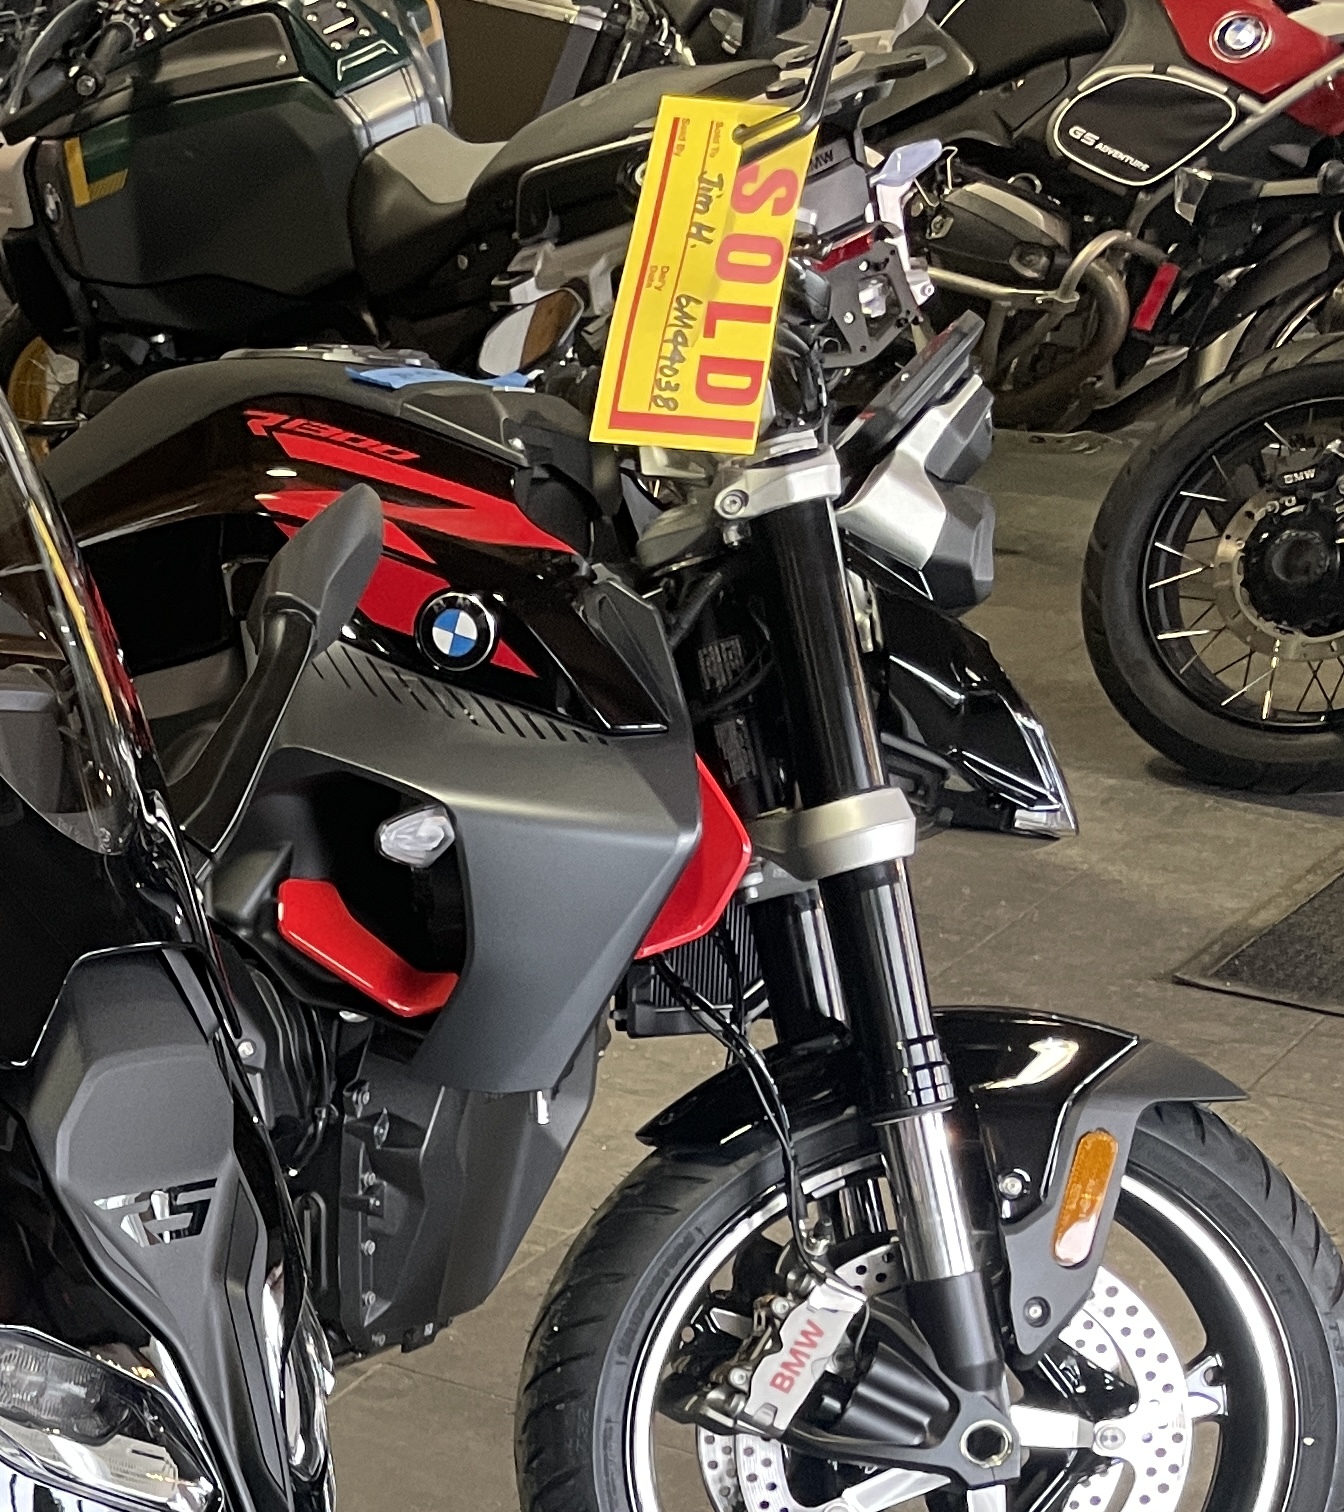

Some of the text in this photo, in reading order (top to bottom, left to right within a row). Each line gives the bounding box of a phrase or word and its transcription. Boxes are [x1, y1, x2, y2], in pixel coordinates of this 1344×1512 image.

[1068, 125, 1150, 172] GS ADVENTURE
[695, 164, 799, 406] SOLD
[1283, 468, 1316, 484] BMW
[93, 1178, 218, 1248] RS
[769, 1318, 825, 1394] BMW
